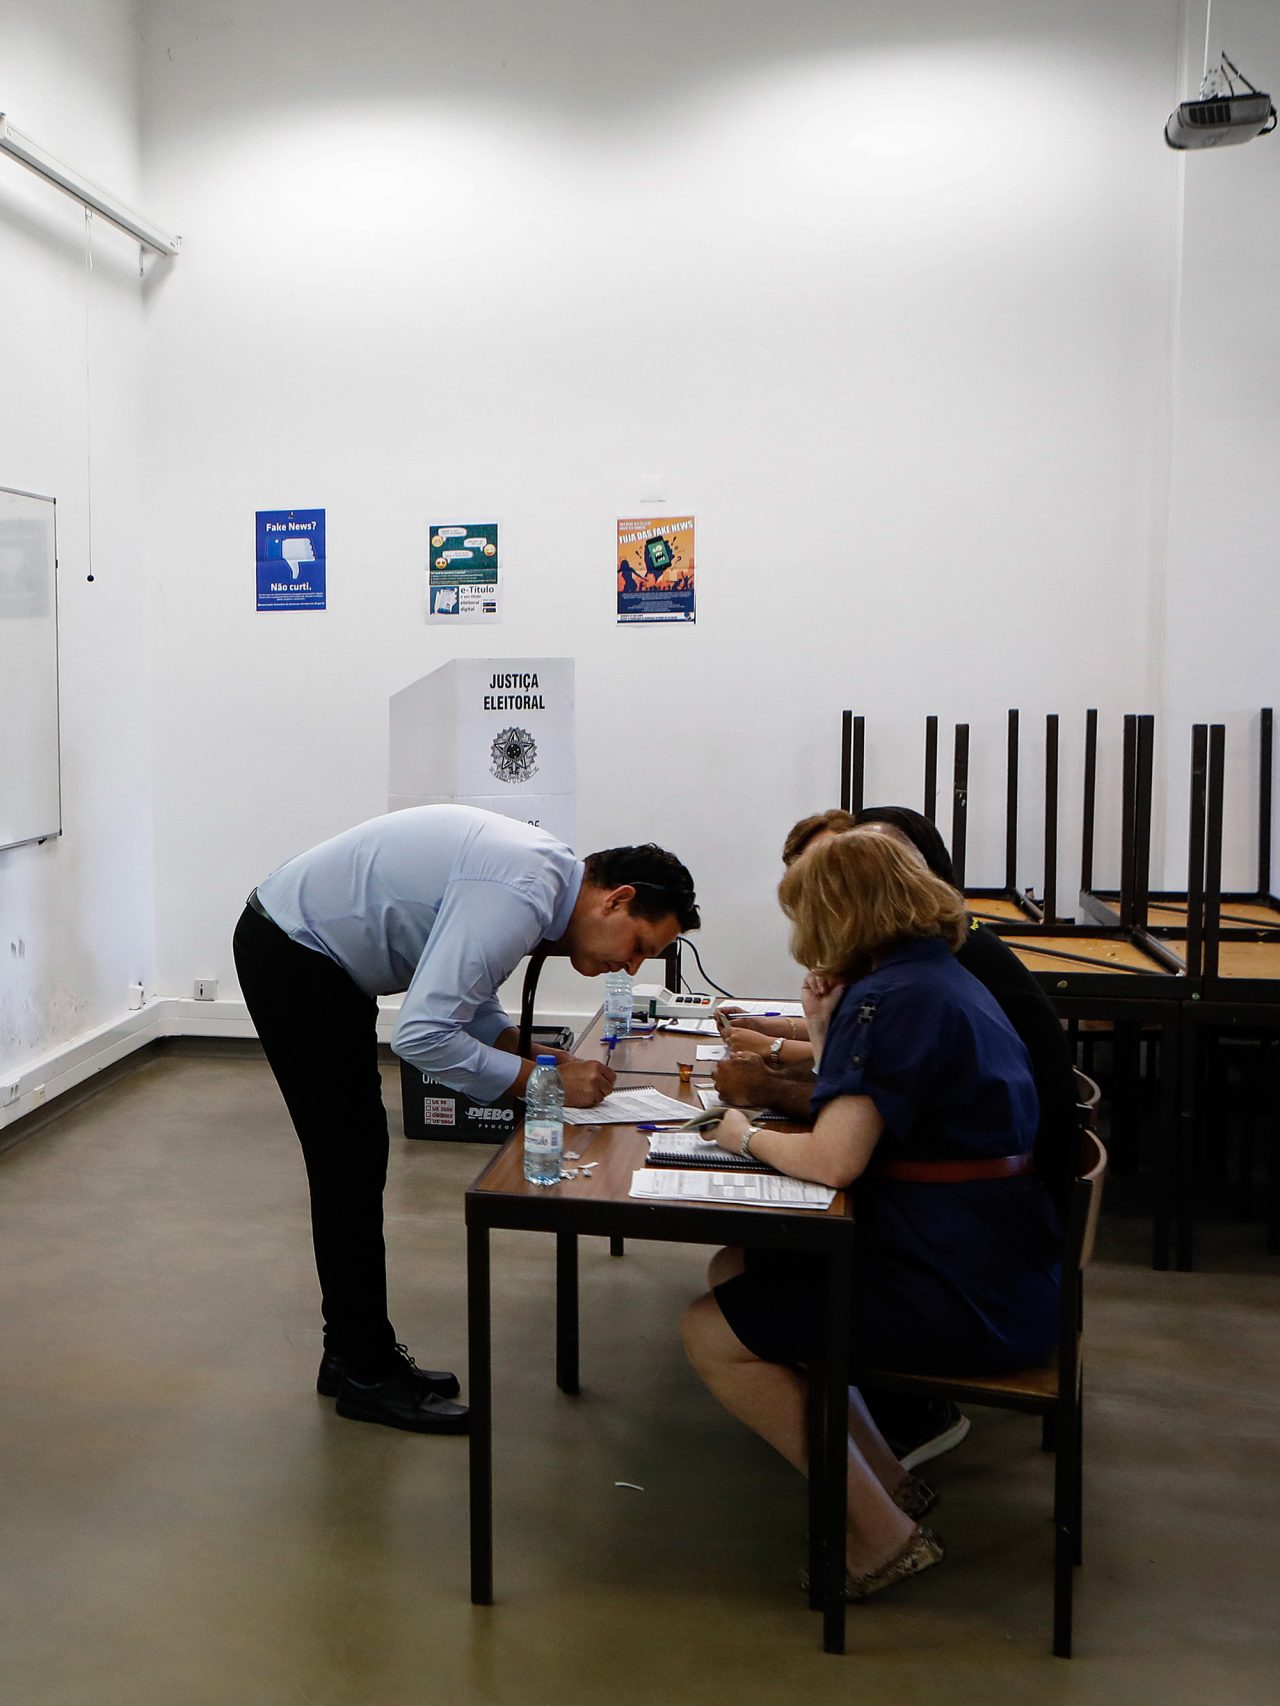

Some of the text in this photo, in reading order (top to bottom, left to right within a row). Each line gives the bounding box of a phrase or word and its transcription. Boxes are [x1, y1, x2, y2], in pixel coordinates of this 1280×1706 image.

[266, 521, 317, 532] Fake News?
[619, 533, 637, 544] FUJA
[637, 530, 653, 540] DAS
[652, 525, 672, 537] FAKE
[671, 520, 694, 533] NEWS
[271, 582, 288, 592] Não
[489, 673, 539, 692] JUSTIÇA
[483, 694, 546, 711] ELEITORAL
